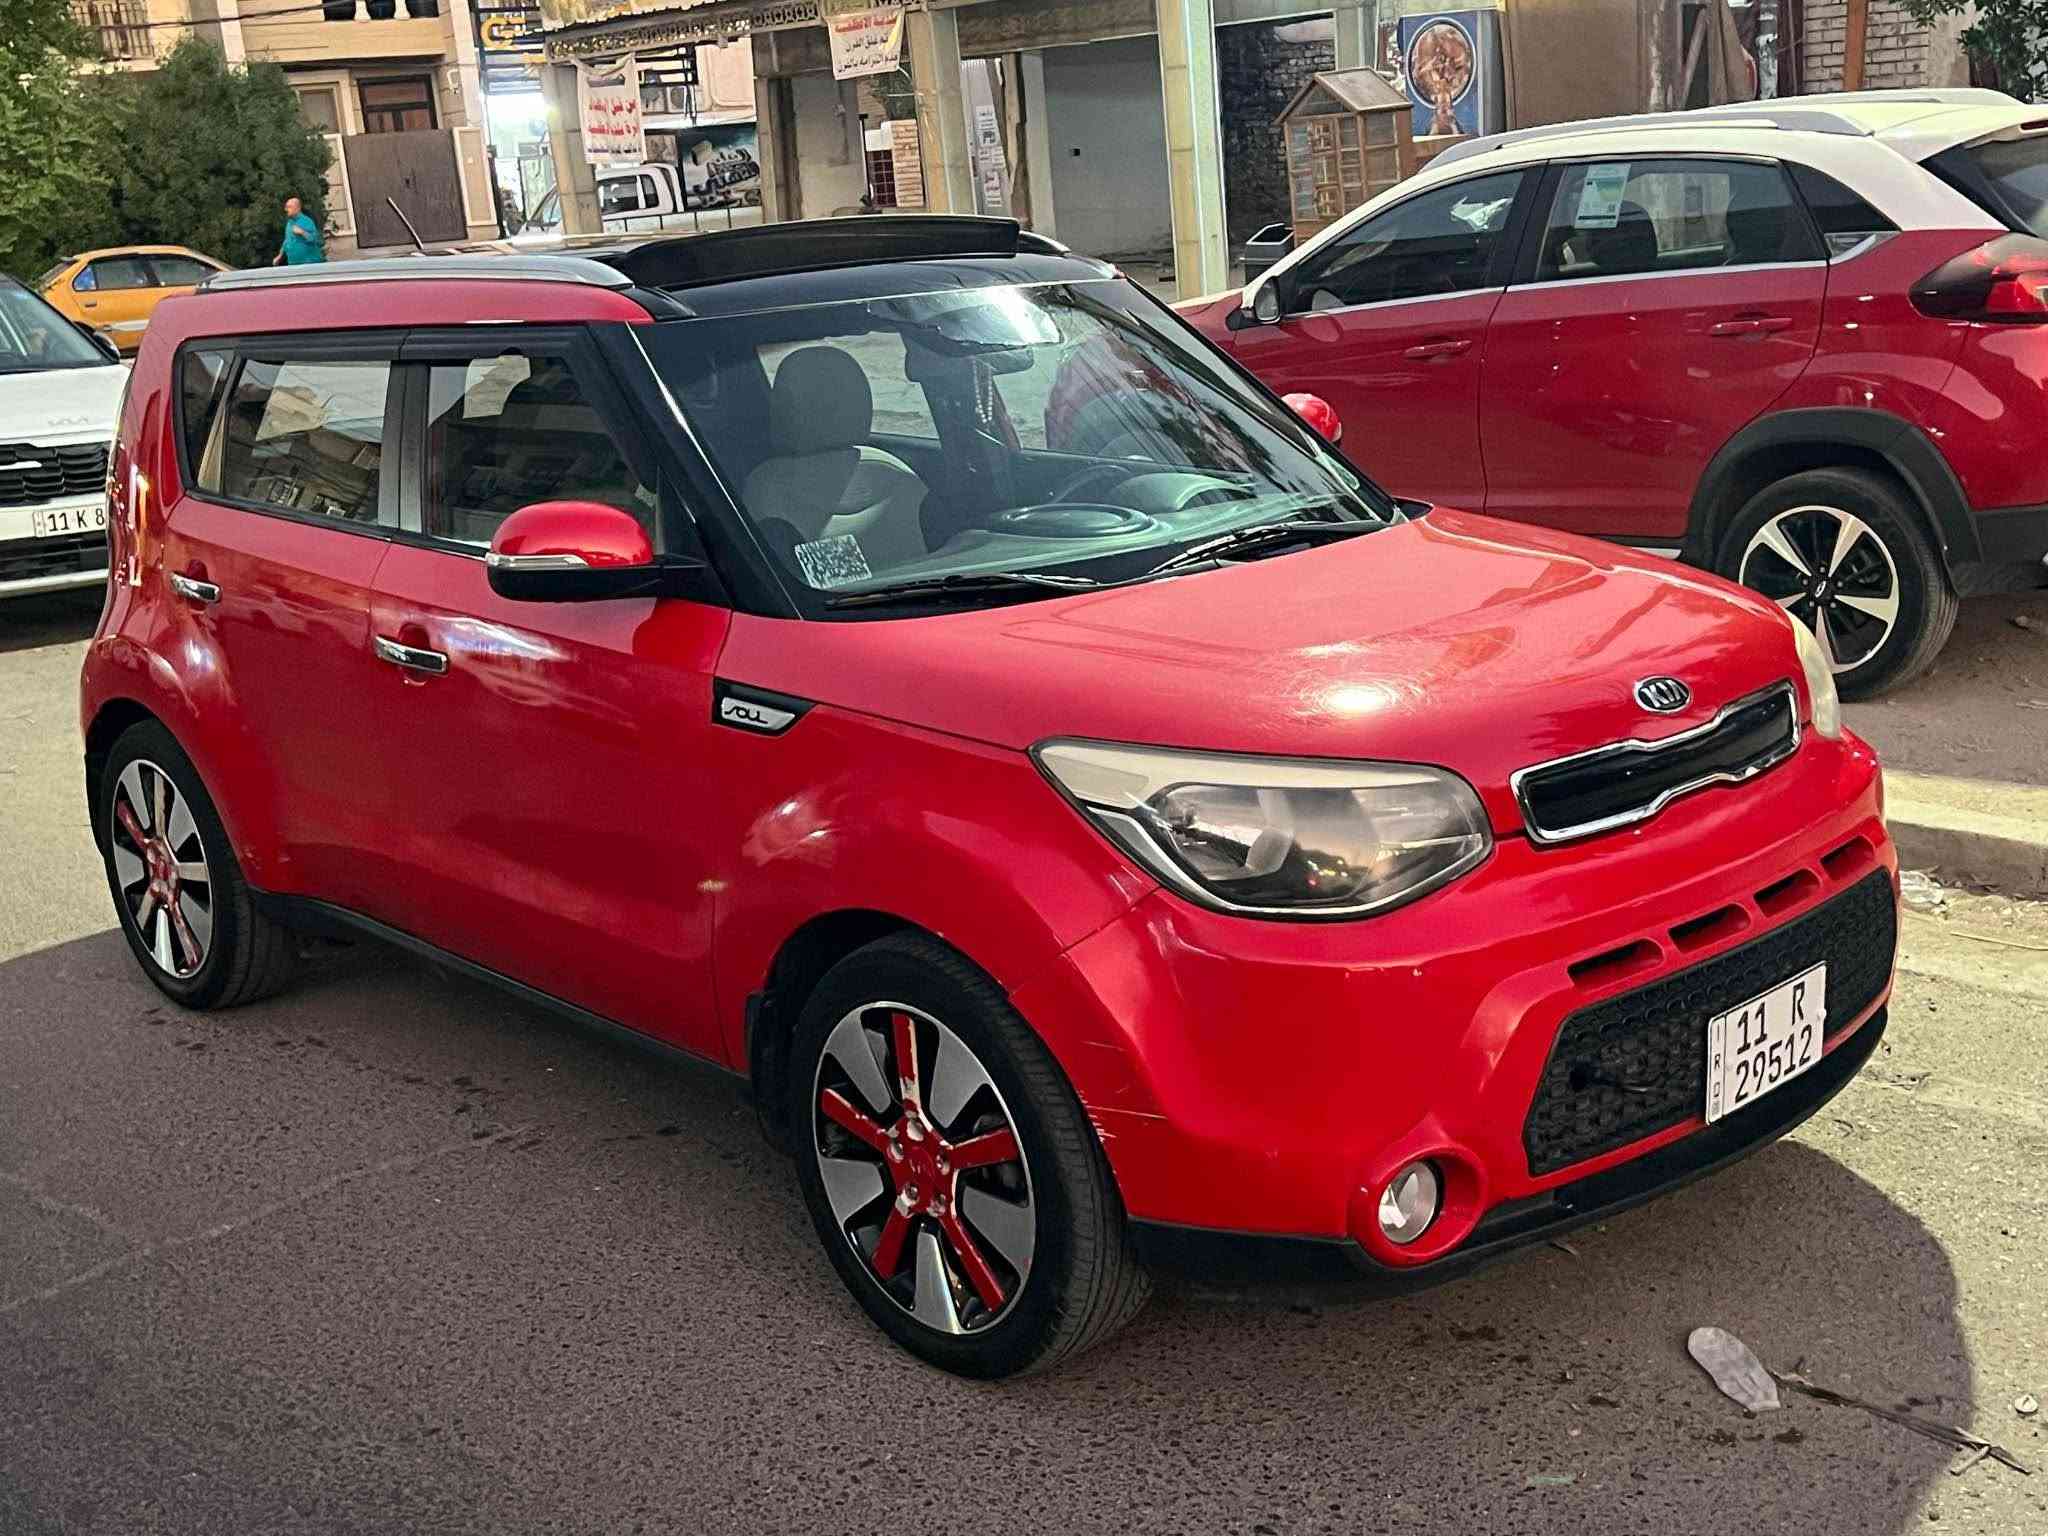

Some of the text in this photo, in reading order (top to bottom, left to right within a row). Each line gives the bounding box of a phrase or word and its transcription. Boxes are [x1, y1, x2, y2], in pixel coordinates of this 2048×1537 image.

[48, 512, 70, 532] 11
[76, 510, 88, 529] K
[1640, 679, 1688, 708] KIA
[1736, 981, 1806, 1055] 11 R
[1735, 1024, 1813, 1103] 29512
